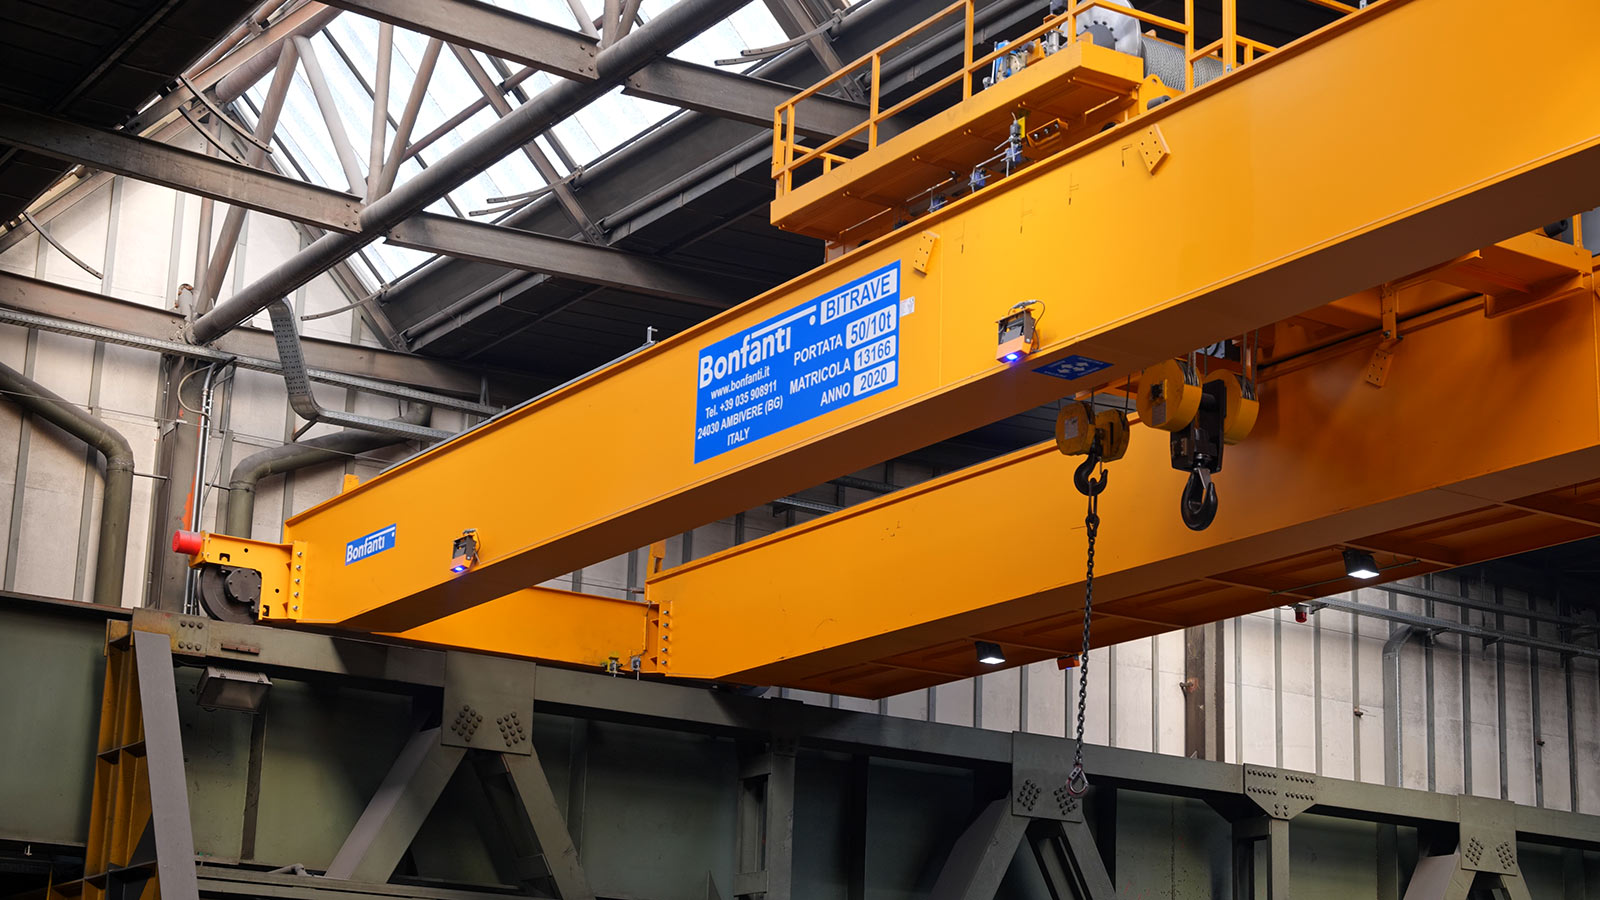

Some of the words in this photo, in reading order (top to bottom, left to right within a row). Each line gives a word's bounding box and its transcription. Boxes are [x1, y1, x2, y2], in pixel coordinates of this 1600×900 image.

[825, 273, 891, 321] BITRAVE
[699, 326, 792, 389] Bonfanti
[793, 333, 843, 366] PORTATA
[850, 311, 892, 344] 50/10t
[710, 365, 771, 400] www.bonfanti.it
[789, 357, 851, 395] MATRICOLA
[857, 340, 891, 367] 13166
[820, 382, 851, 407] ANNO
[859, 367, 888, 392] 2020
[697, 420, 720, 440] 24030
[720, 403, 763, 431] AMBIVERE
[764, 395, 783, 415] (BG)
[705, 404, 719, 419] Tel.
[719, 398, 734, 412] +39
[735, 391, 749, 407] 035
[750, 379, 777, 401] 908911
[727, 426, 750, 446] ITALY
[346, 536, 385, 562] Bonfanti
